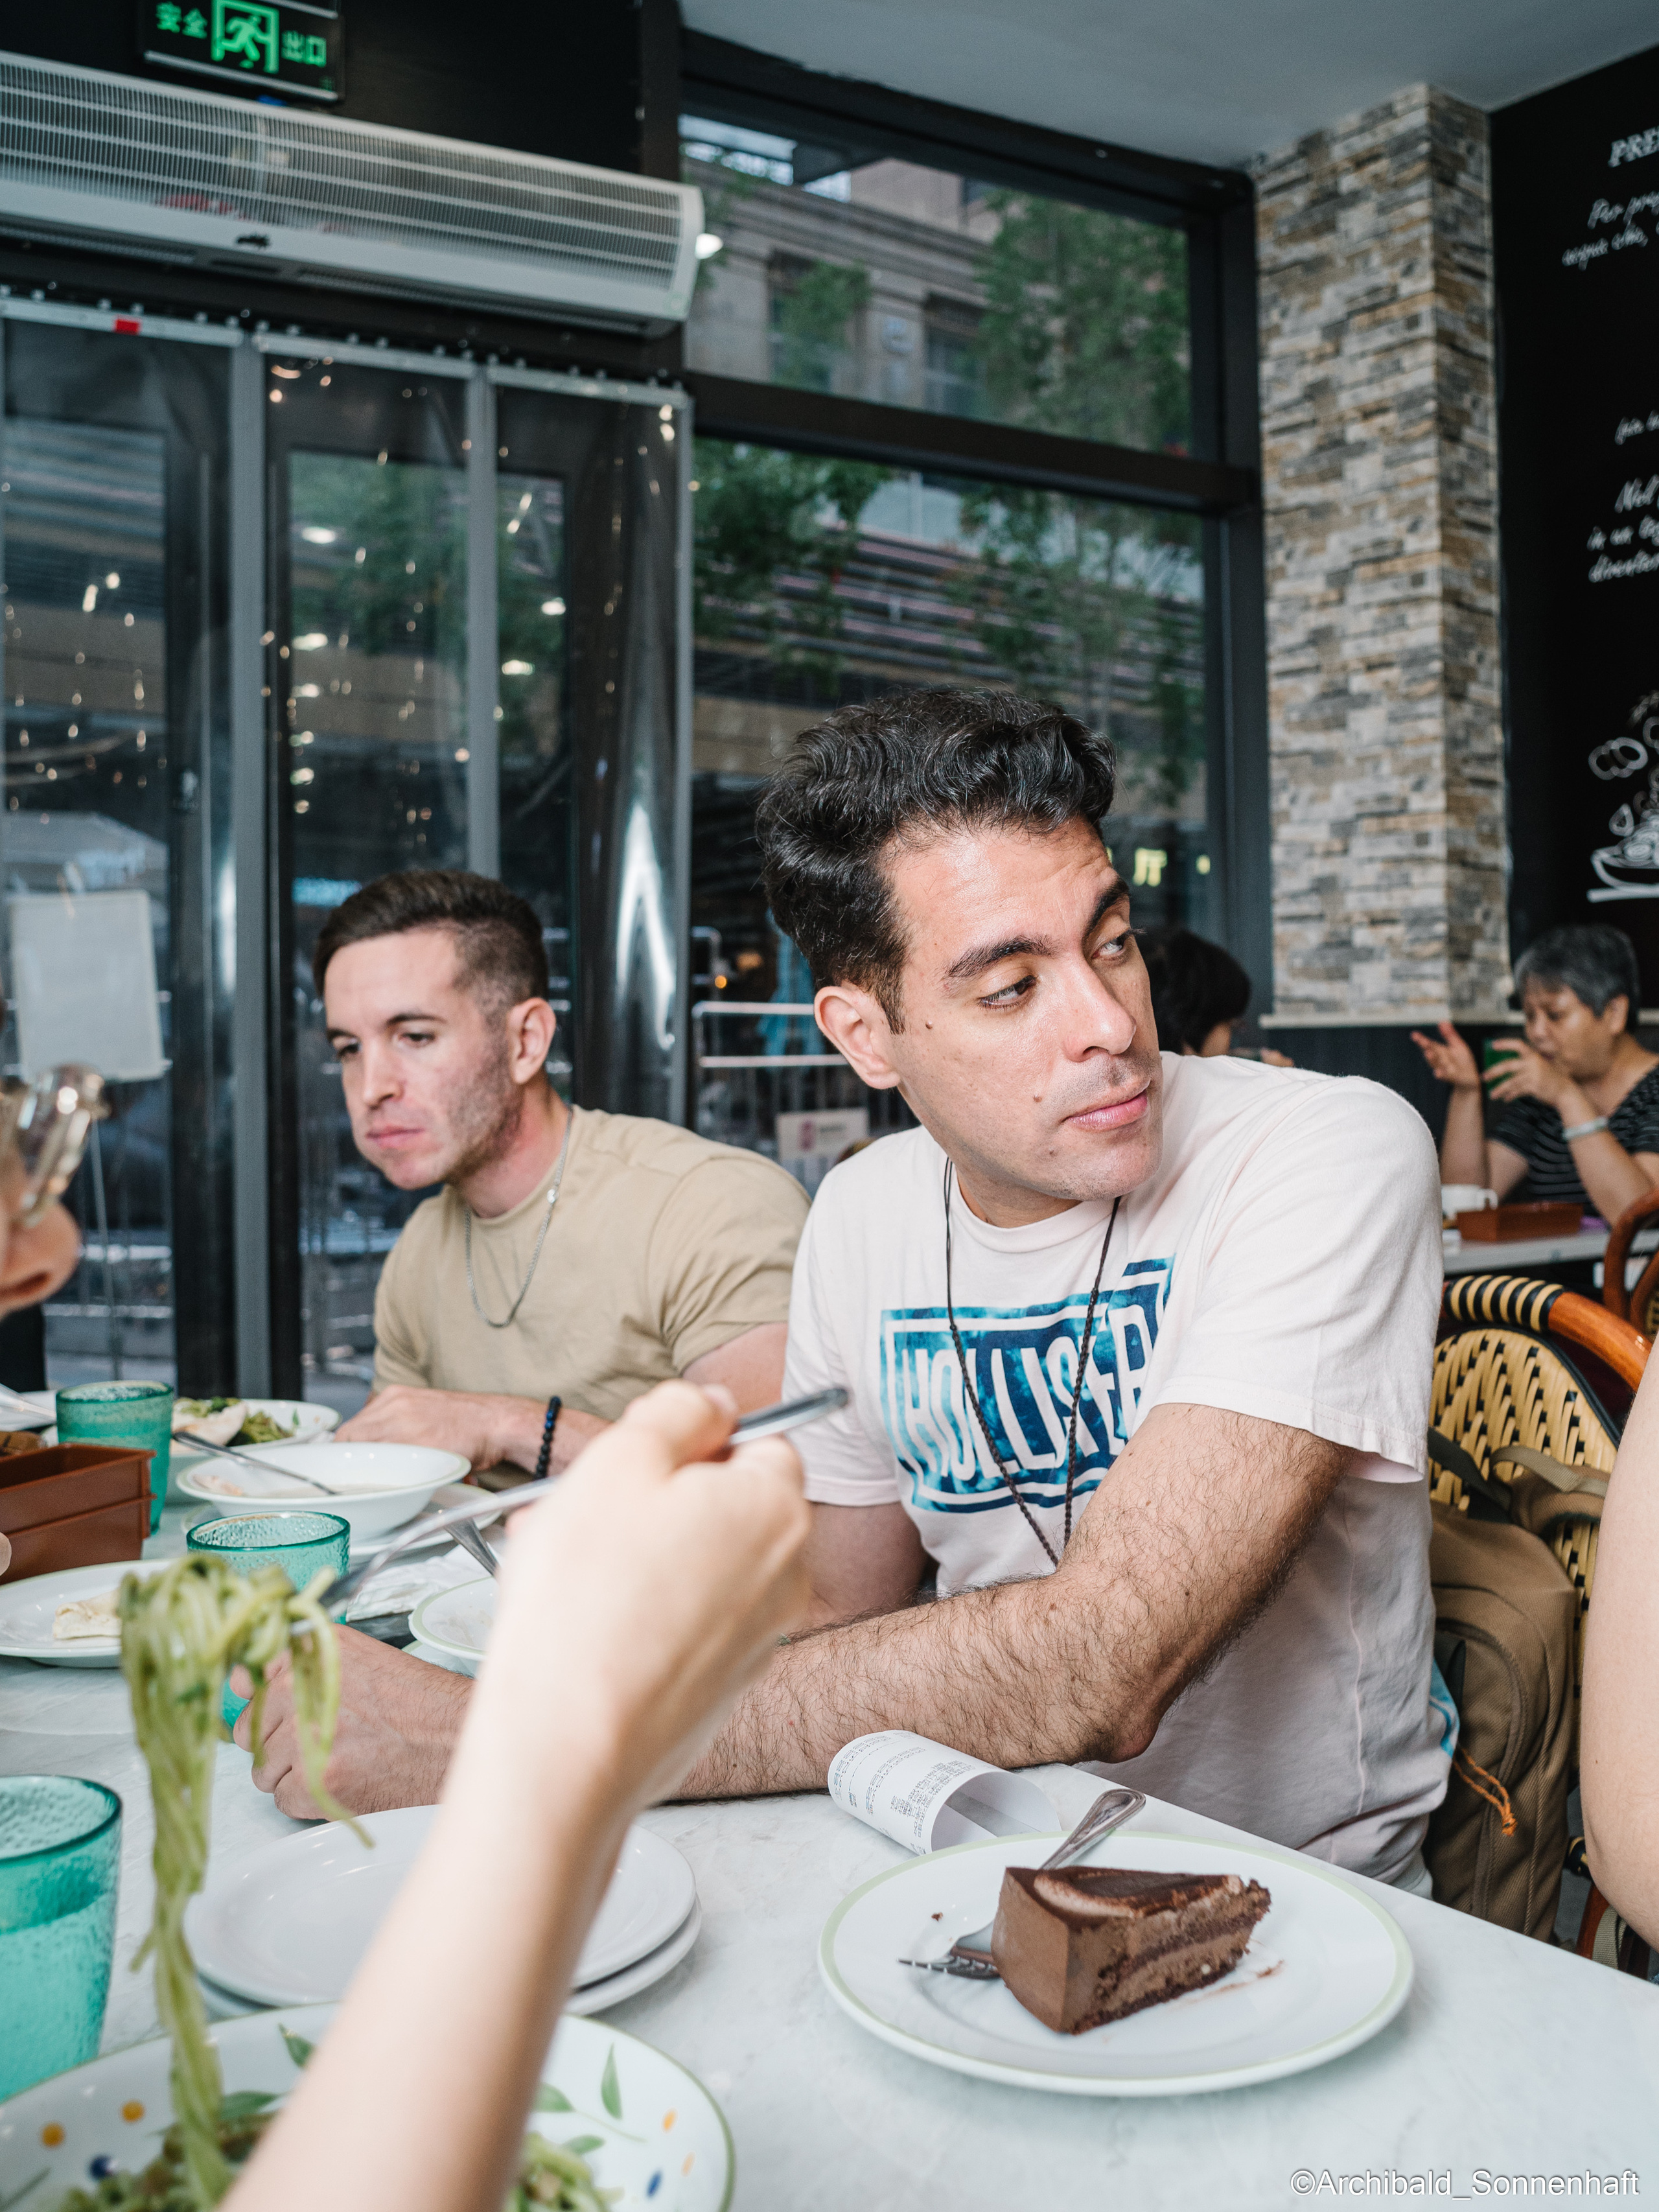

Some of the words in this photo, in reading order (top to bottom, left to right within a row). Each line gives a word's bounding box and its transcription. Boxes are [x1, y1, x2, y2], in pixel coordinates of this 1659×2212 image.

[155, 1, 208, 40] 安全
[281, 30, 327, 67] 出口
[1608, 124, 1659, 168] PRE
